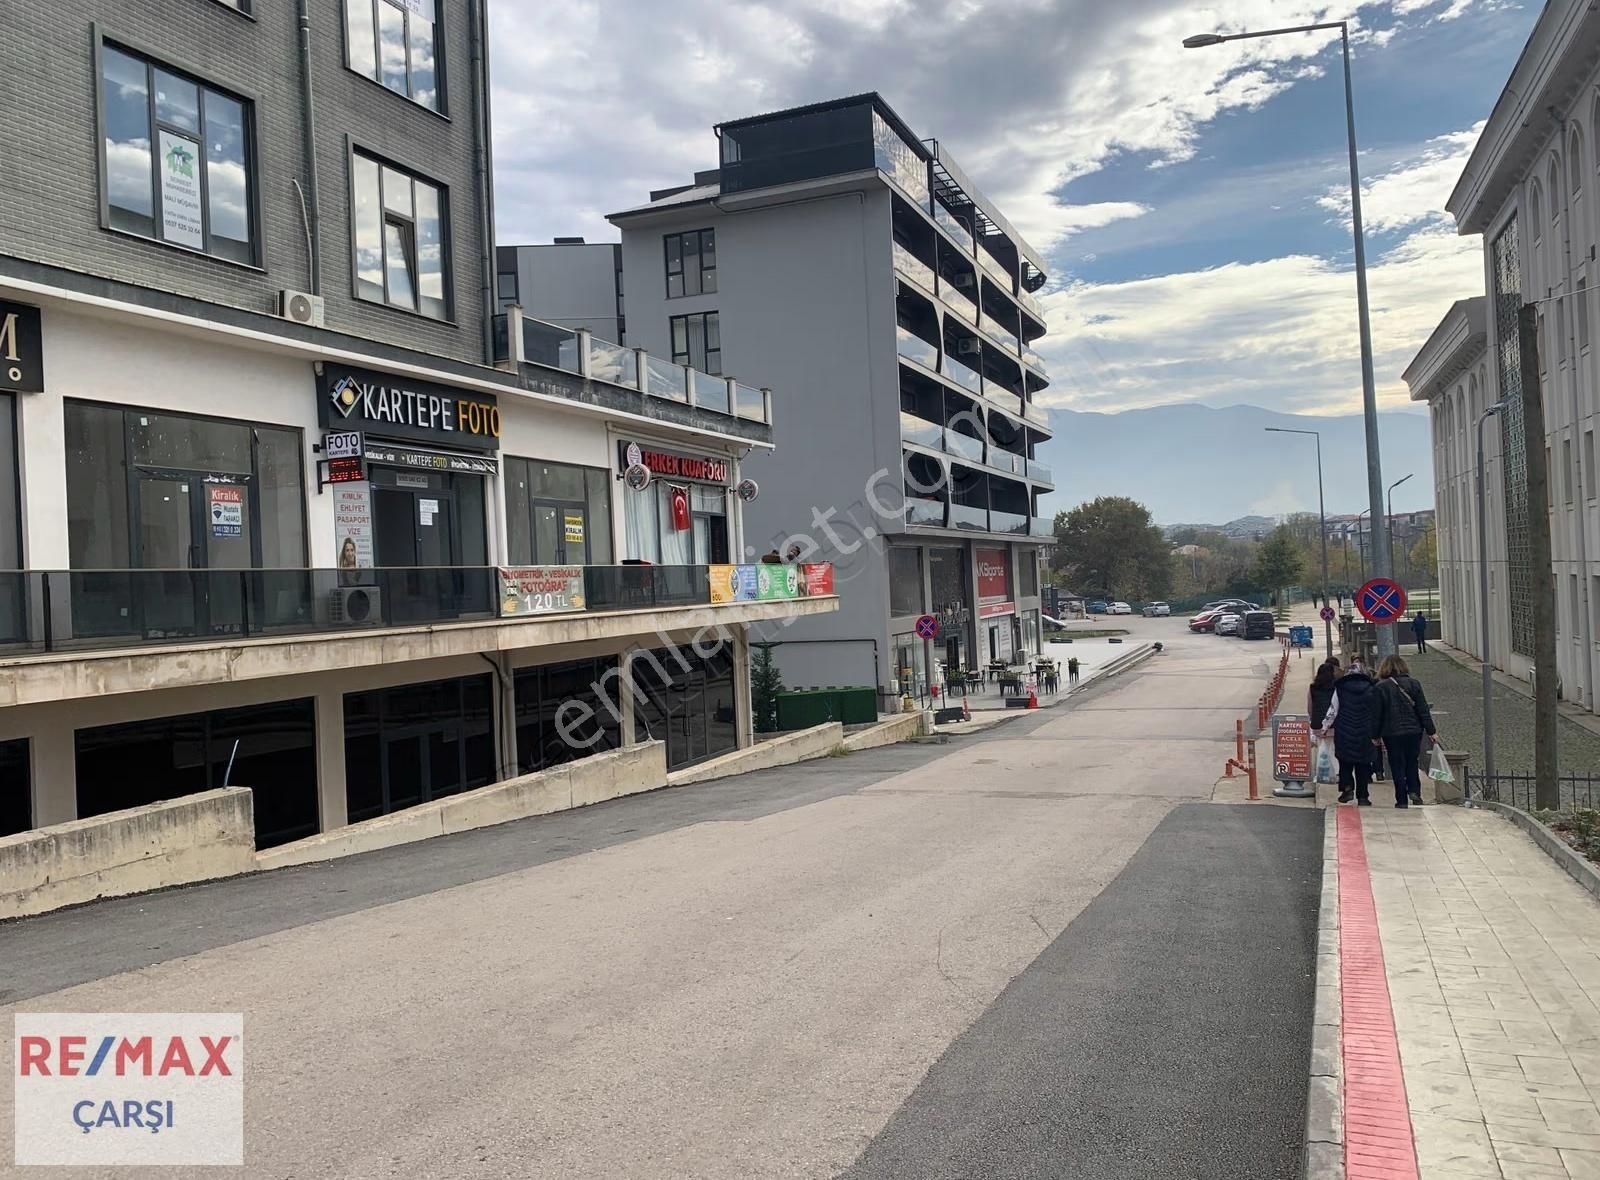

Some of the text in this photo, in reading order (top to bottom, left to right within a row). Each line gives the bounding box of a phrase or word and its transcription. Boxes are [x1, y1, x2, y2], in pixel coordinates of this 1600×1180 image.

[363, 384, 500, 438] KARTEPE FOTO
[327, 433, 359, 450] FOTO
[406, 454, 433, 467] KARTEPE
[433, 456, 448, 469] FOTO
[643, 451, 680, 474] ERKEK
[681, 458, 727, 481] KUAFÖRÜ
[340, 503, 365, 512] EHLİYET
[336, 515, 369, 524] PASAPORT
[346, 527, 361, 535] VİZE
[502, 568, 544, 579] BİYOMETRİK
[549, 567, 581, 578] VESİKALIK
[520, 579, 569, 593] FOTOĞRAF
[524, 593, 568, 611] 120 TL
